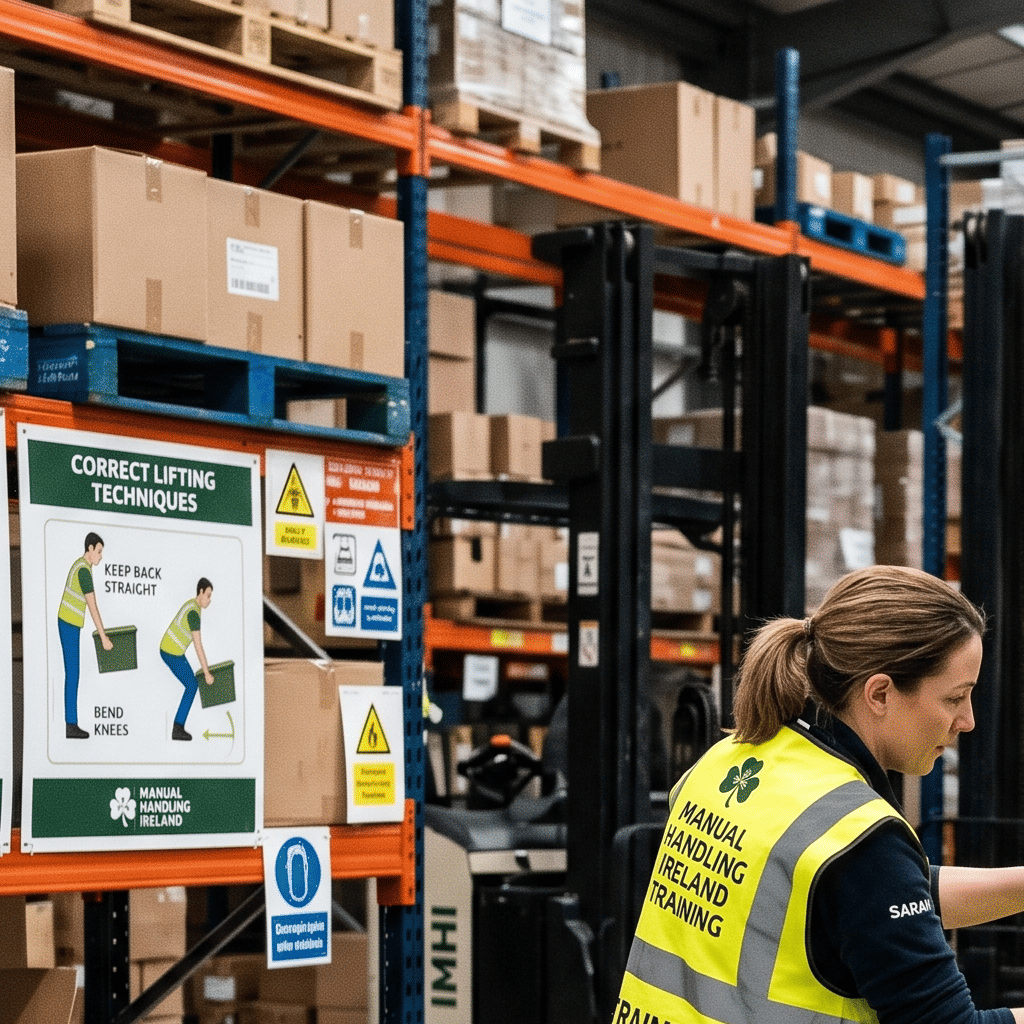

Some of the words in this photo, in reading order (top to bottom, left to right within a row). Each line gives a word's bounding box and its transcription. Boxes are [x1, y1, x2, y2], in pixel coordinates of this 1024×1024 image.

[71, 454, 150, 482] CORRECT
[154, 464, 216, 491] LIFTING
[91, 482, 198, 514] TECHNIQUES
[104, 563, 131, 577] KEEP
[134, 566, 162, 580] BACK
[104, 580, 157, 596] STRAIGHT
[94, 706, 124, 719] BEND
[94, 723, 129, 736] KNEES
[139, 786, 183, 799] MANUAL
[139, 814, 183, 828] IRELAND
[678, 801, 747, 852] MANUAL
[663, 823, 748, 885] HANDLING
[657, 853, 729, 908] IRELAND
[649, 879, 724, 938] TRAINING
